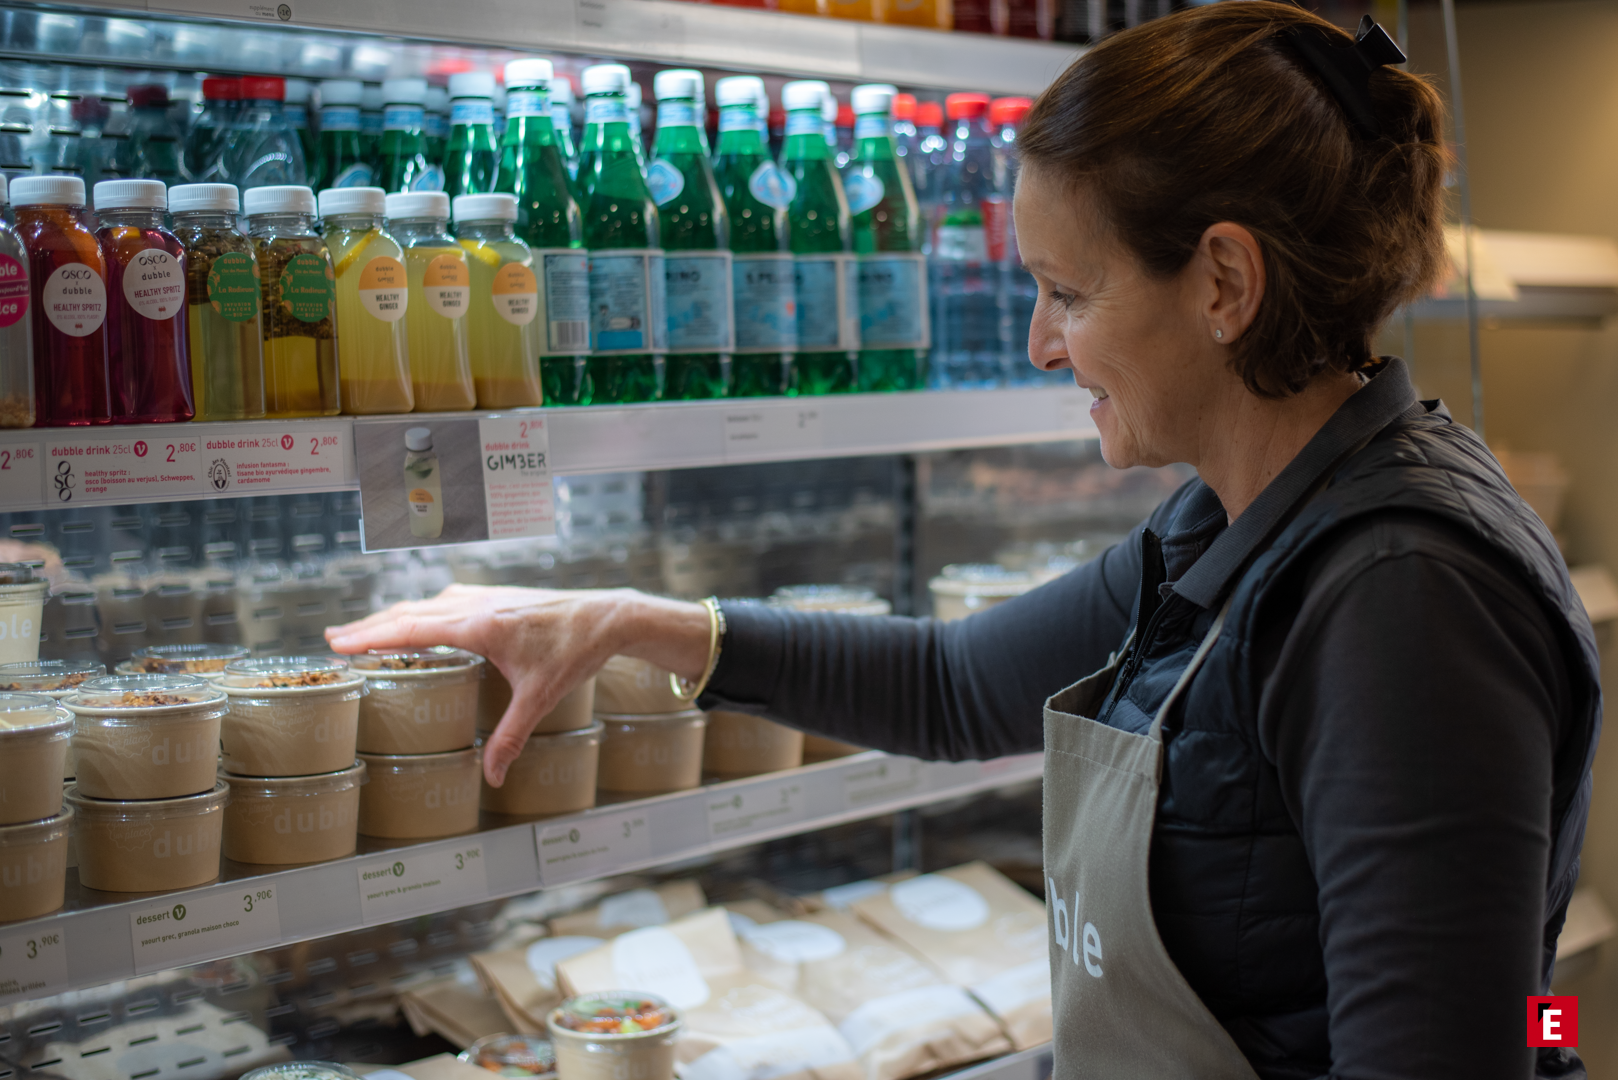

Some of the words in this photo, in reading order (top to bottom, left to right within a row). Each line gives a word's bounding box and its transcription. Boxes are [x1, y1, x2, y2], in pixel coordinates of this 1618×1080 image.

[139, 254, 168, 266] OSCO
[62, 270, 91, 280] OSCO
[142, 271, 170, 280] dubble
[134, 288, 162, 298] HEALTHY
[163, 286, 181, 294] SPRITZ
[300, 286, 327, 294] Radieuse
[439, 291, 462, 299] HEALTHY
[376, 294, 400, 302] HEALTHY
[54, 304, 80, 312] HEALTHY
[82, 304, 102, 312] SPRITZ
[379, 302, 398, 310] GINGER
[206, 440, 235, 450] dubble
[238, 438, 260, 448] drink
[262, 438, 279, 448] 25cl
[486, 443, 510, 452] dubble
[512, 442, 530, 450] drink
[52, 446, 84, 456] dubble
[86, 445, 110, 456] drink
[112, 445, 132, 454] 25cl
[85, 470, 108, 480] healthy
[110, 470, 127, 478] spritz
[266, 468, 299, 477] ayurvédique
[363, 866, 392, 880] dessert
[367, 890, 384, 900] yaourt
[385, 888, 396, 897] grec
[403, 884, 422, 893] granola
[423, 880, 441, 889] maison
[136, 910, 170, 925] dessert
[142, 937, 160, 947] yaourt
[162, 934, 176, 943] grec,
[178, 928, 200, 938] granola
[201, 924, 222, 934] maison
[223, 920, 239, 929] choco
